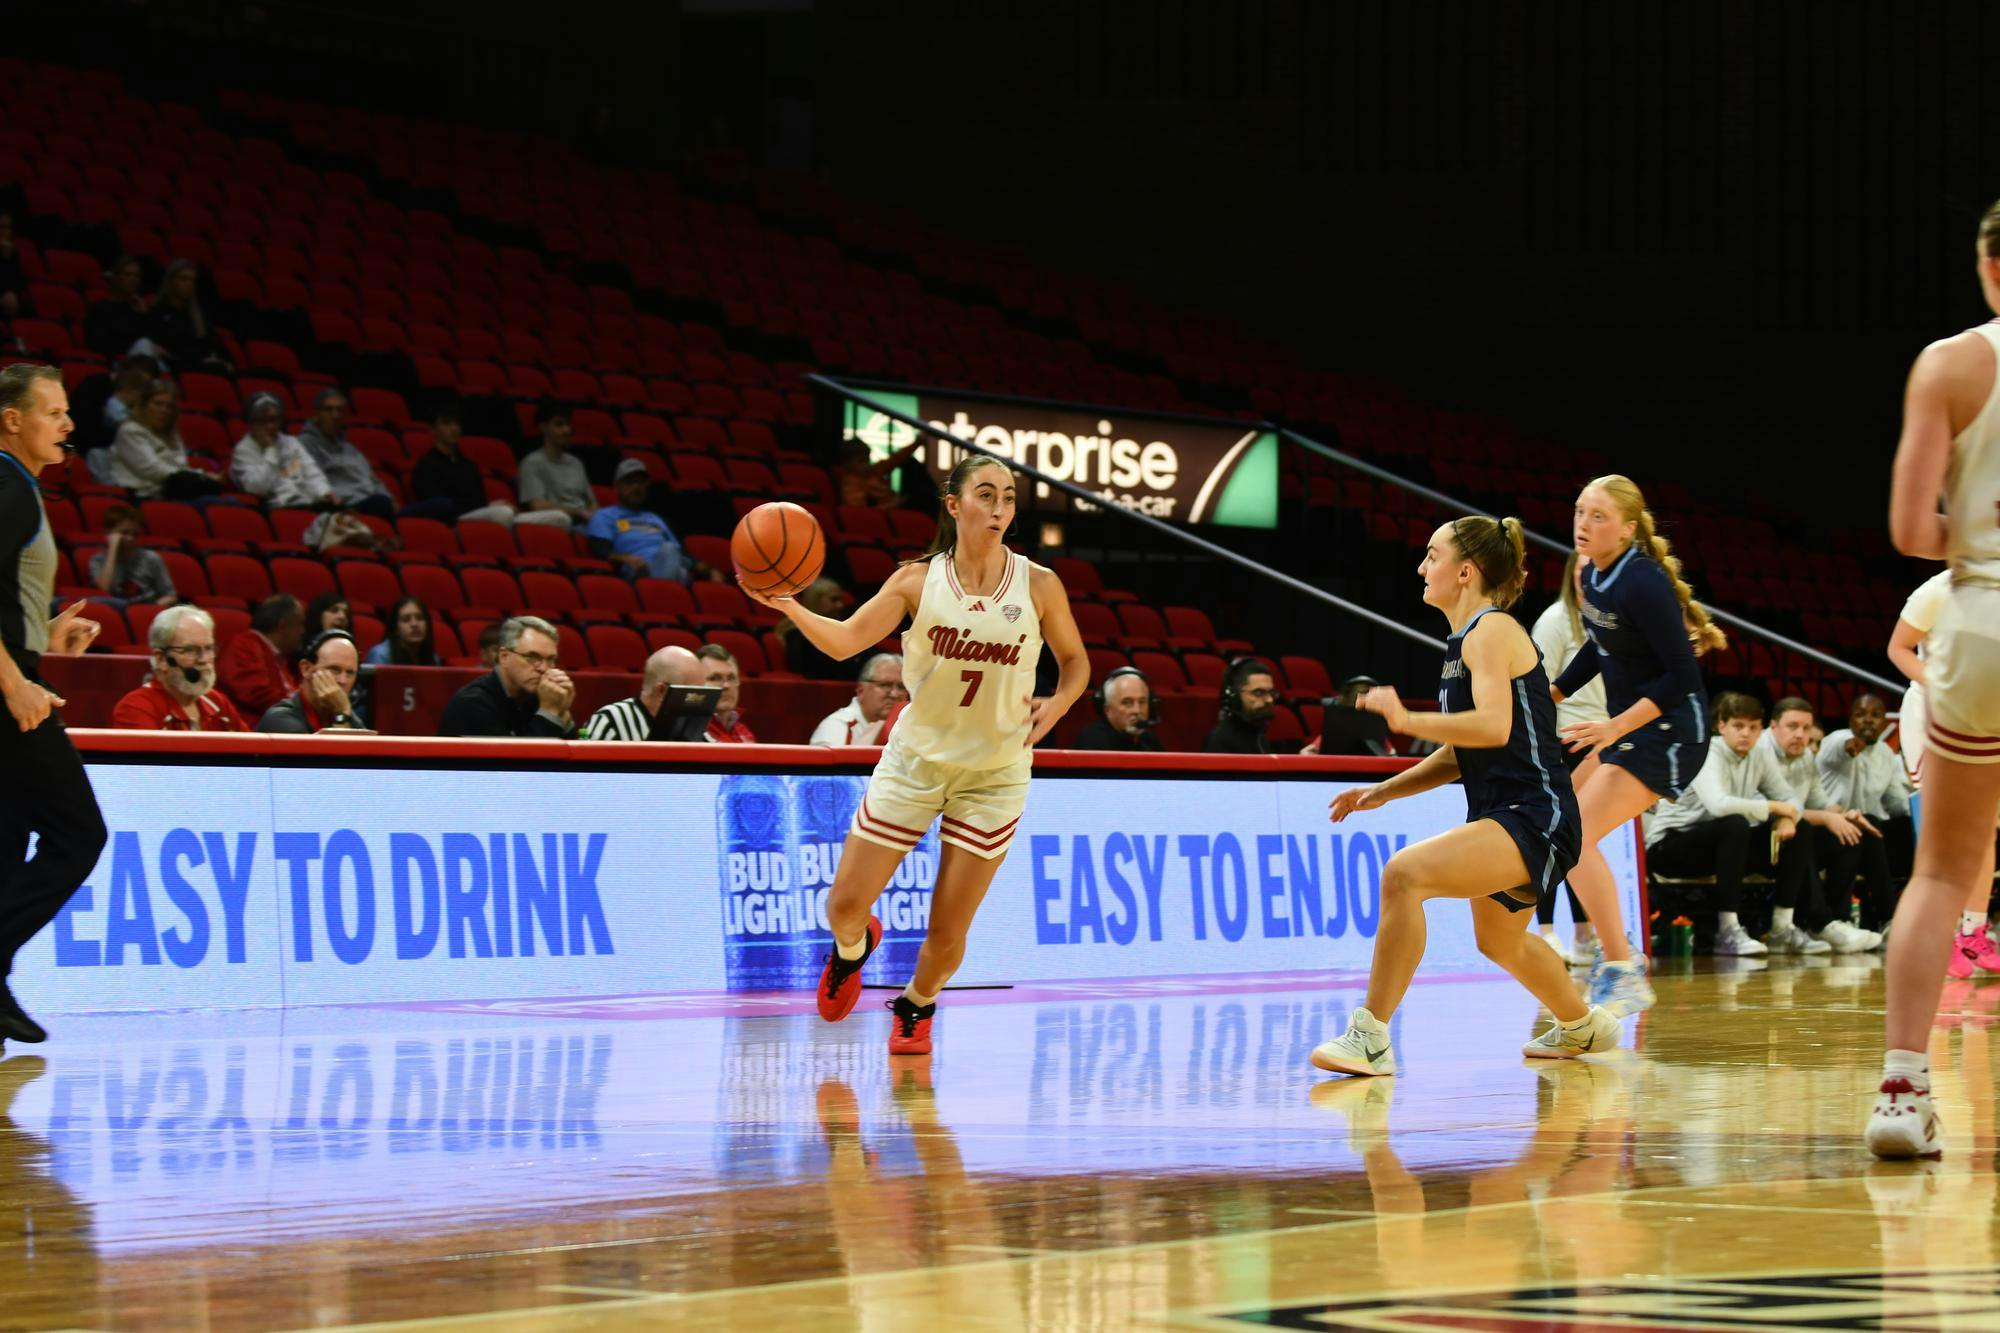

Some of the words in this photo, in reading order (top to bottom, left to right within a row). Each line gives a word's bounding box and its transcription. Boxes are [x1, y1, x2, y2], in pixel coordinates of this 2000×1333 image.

[928, 625, 1027, 666] Miami
[403, 687, 415, 711] 5
[959, 670, 984, 707] 7
[728, 850, 791, 893] BUD
[801, 842, 843, 886] BU
[885, 851, 932, 889] UD
[273, 828, 376, 965] TO
[389, 832, 615, 960] DRINK
[1031, 832, 1168, 945] EASY
[1178, 832, 1248, 942] TO
